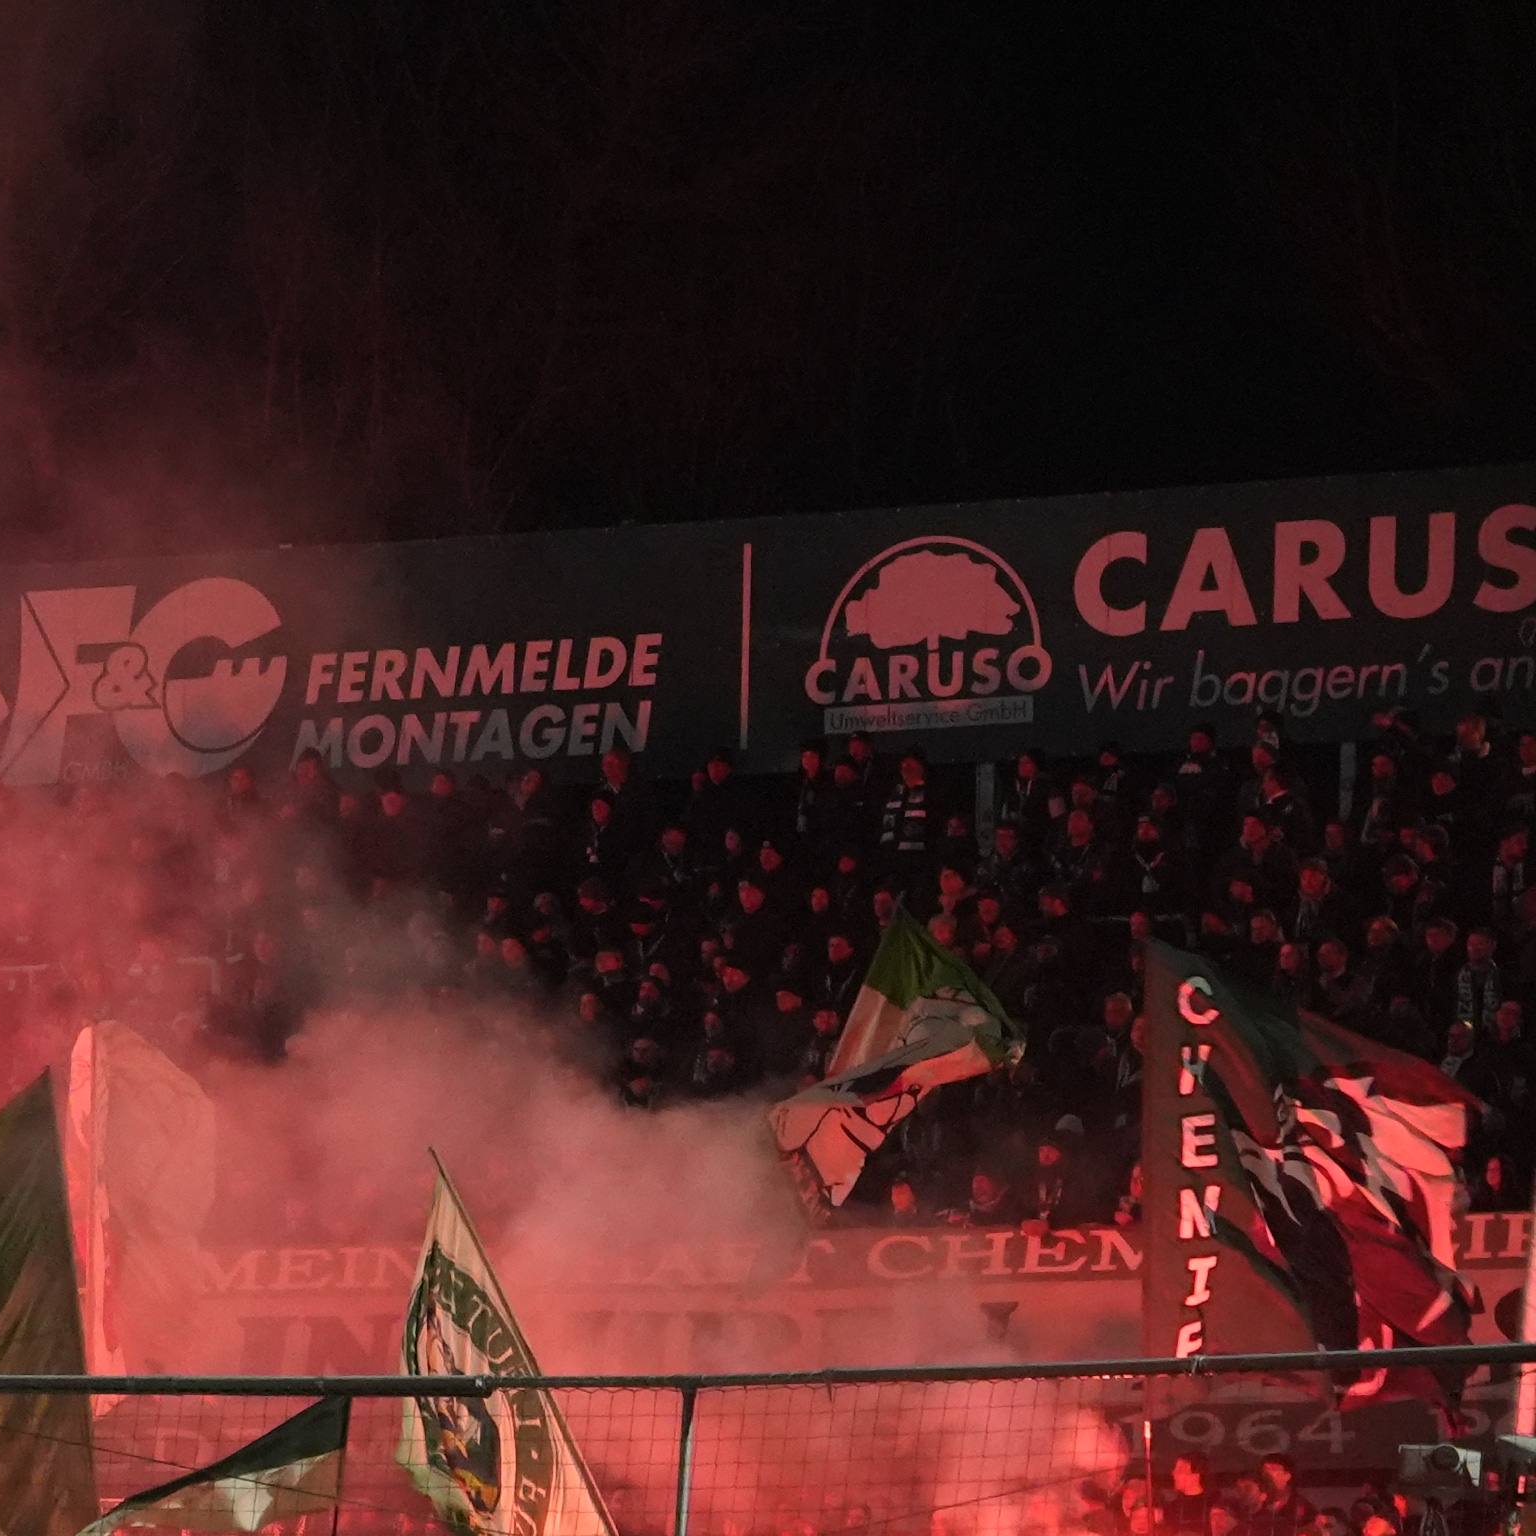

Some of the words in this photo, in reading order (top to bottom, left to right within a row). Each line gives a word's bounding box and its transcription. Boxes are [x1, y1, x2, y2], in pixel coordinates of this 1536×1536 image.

[306, 633, 662, 705] FERNMELDE
[805, 645, 1052, 705] CARUSO
[1078, 661, 1174, 714] Wir
[289, 700, 651, 772] MONTAGEN
[830, 706, 961, 731] Umweltservice
[966, 699, 1027, 722] GmbH
